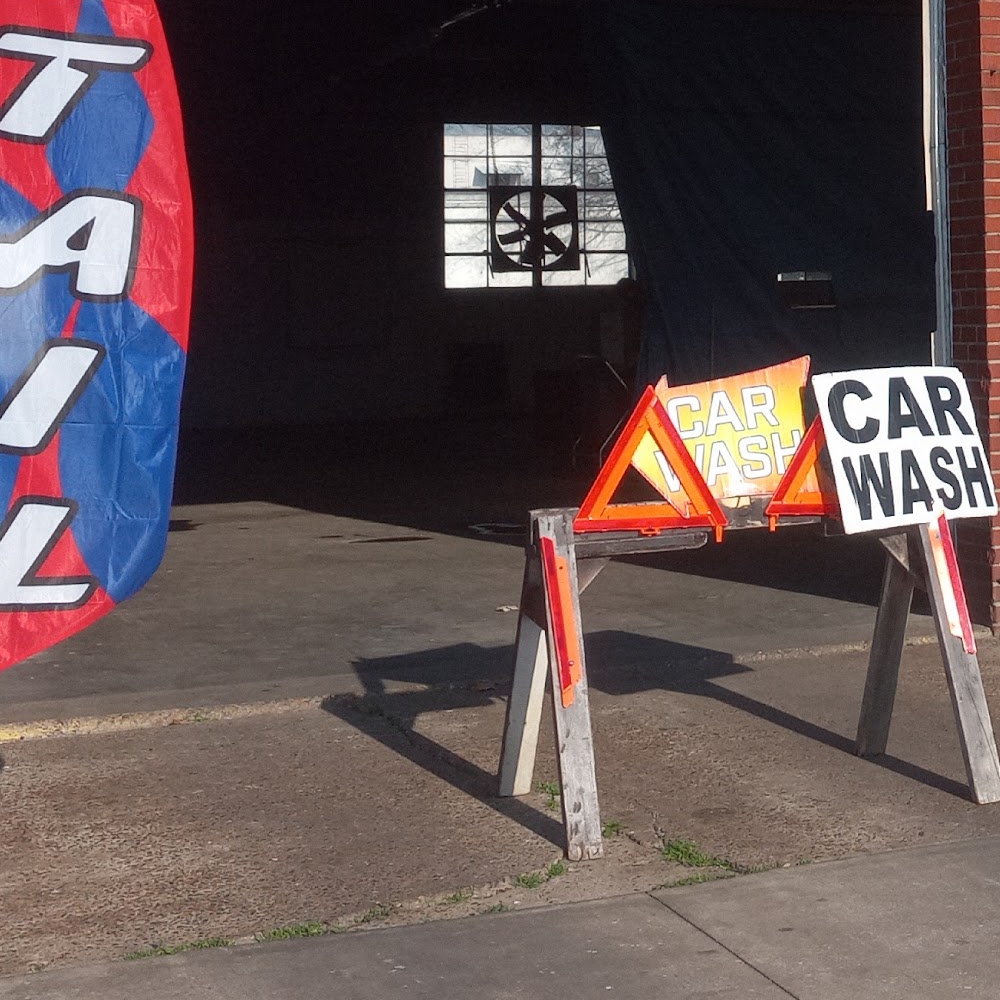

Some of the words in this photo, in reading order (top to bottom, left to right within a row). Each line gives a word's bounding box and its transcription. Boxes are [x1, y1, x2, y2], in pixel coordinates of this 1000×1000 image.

[667, 385, 780, 440] CAR
[827, 375, 974, 444] CAR
[841, 446, 994, 520] WASH
